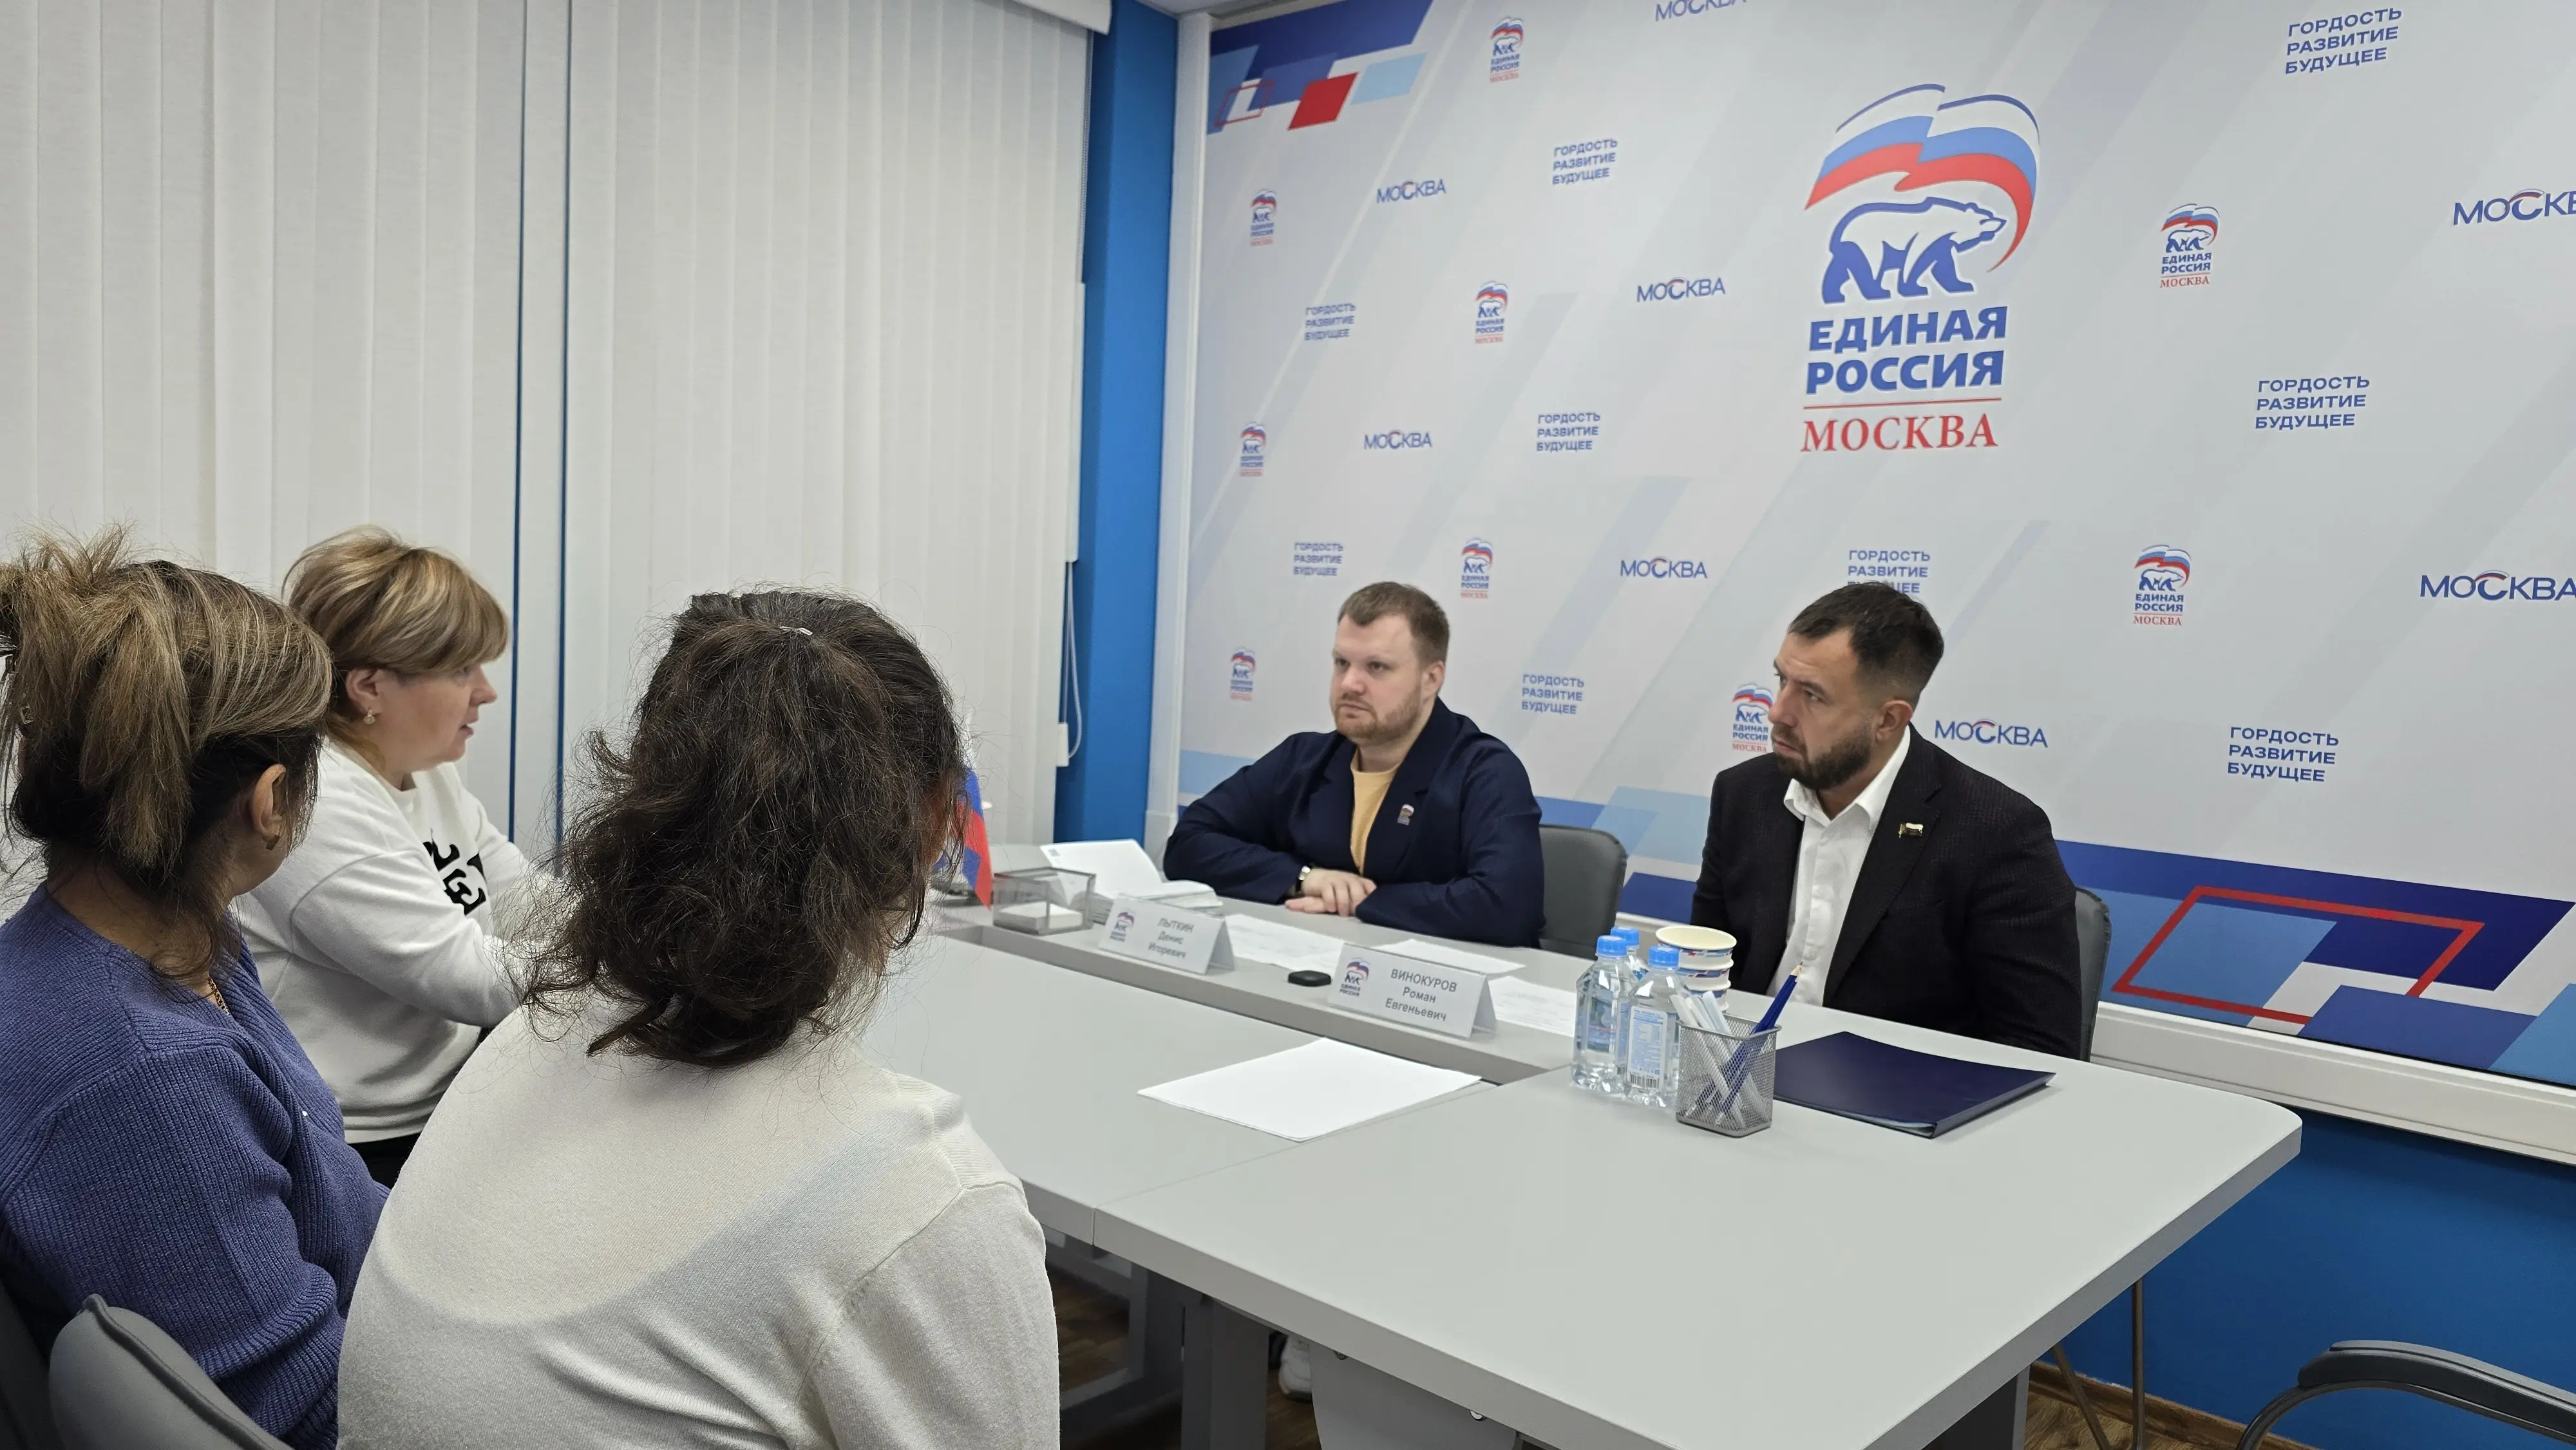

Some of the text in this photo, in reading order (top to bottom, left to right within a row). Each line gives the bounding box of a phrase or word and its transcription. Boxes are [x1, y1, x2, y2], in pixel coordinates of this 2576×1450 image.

[2289, 8, 2401, 37] ГОРДОСТЬ
[2288, 26, 2398, 55] РАЗВИТИЕ
[2286, 47, 2387, 74] БУДУЩЕЕ
[1555, 139, 1618, 157] ГОРДОСТЬ
[1554, 153, 1615, 171] РАЗВИТИЕ
[1553, 168, 1609, 185] БУДУЩЕЕ
[1378, 179, 1446, 203] МОСКВА
[2163, 252, 2211, 265] ЕДИНАЯ
[2162, 262, 2211, 274] РОССИЯ
[2161, 274, 2209, 288] МОСКВА
[1638, 278, 1725, 302] МОСКВА
[1306, 303, 1356, 315] ГОРДОСТЬ
[1306, 315, 1354, 328] РАЗВИТИЕ
[1810, 306, 2007, 351] ЕДИНАЯ
[1305, 329, 1350, 341] БУДУЩЕЕ
[1807, 350, 2004, 394] РОССИЯ
[2259, 376, 2369, 393] ГОРДОСТЬ
[2258, 395, 2366, 410] РАЗВИТИЕ
[1539, 412, 1600, 424] ГОРДОСТЬ
[2257, 414, 2355, 430] БУДУЩЕЕ
[1538, 426, 1598, 437] РАЗВИТИЕ
[1802, 413, 1998, 451] МОСКВА
[1365, 431, 1432, 449] МОСКВА
[1537, 440, 1592, 452] БУДУЩЕЕ
[1295, 542, 1343, 552] ГОРДОСТЬ
[1294, 555, 1342, 563] РАЗВИТИЕ
[1850, 550, 1930, 563] ГОРДОСТЬ
[1294, 567, 1337, 576] БУДУЩЕЕ
[1621, 558, 1707, 578] МОСКВА
[1849, 566, 1928, 578] РАЗВИТИЕ
[2136, 594, 2184, 602] ЕДИНАЯ
[2136, 603, 2183, 612] РОССИЯ
[2134, 615, 2181, 625] МОСКВА
[1524, 674, 1584, 688] ГОРДОСТЬ
[1523, 688, 1582, 701] РАЗВИТИЕ
[1522, 701, 1577, 714] БУДУЩЕЕ
[1732, 723, 1769, 732] ЕДИНАЯ
[1936, 720, 2048, 748] МОСКВА
[1732, 732, 1768, 741] РОССИЯ
[2231, 727, 2338, 746] ГОРДОСТЬ
[1732, 743, 1767, 753] МОСКВА
[2230, 744, 2335, 764] РАЗВИТИЕ
[2229, 762, 2325, 782] БУДУЩЕЕ
[1159, 918, 1194, 932] ЛЫТКИН
[1159, 931, 1183, 945] Денис
[1149, 943, 1186, 958] Игоревич
[1392, 969, 1457, 992] ВИНОКУРОВ
[1403, 987, 1436, 1003] Роман
[1386, 998, 1446, 1021] Евгеньевич
